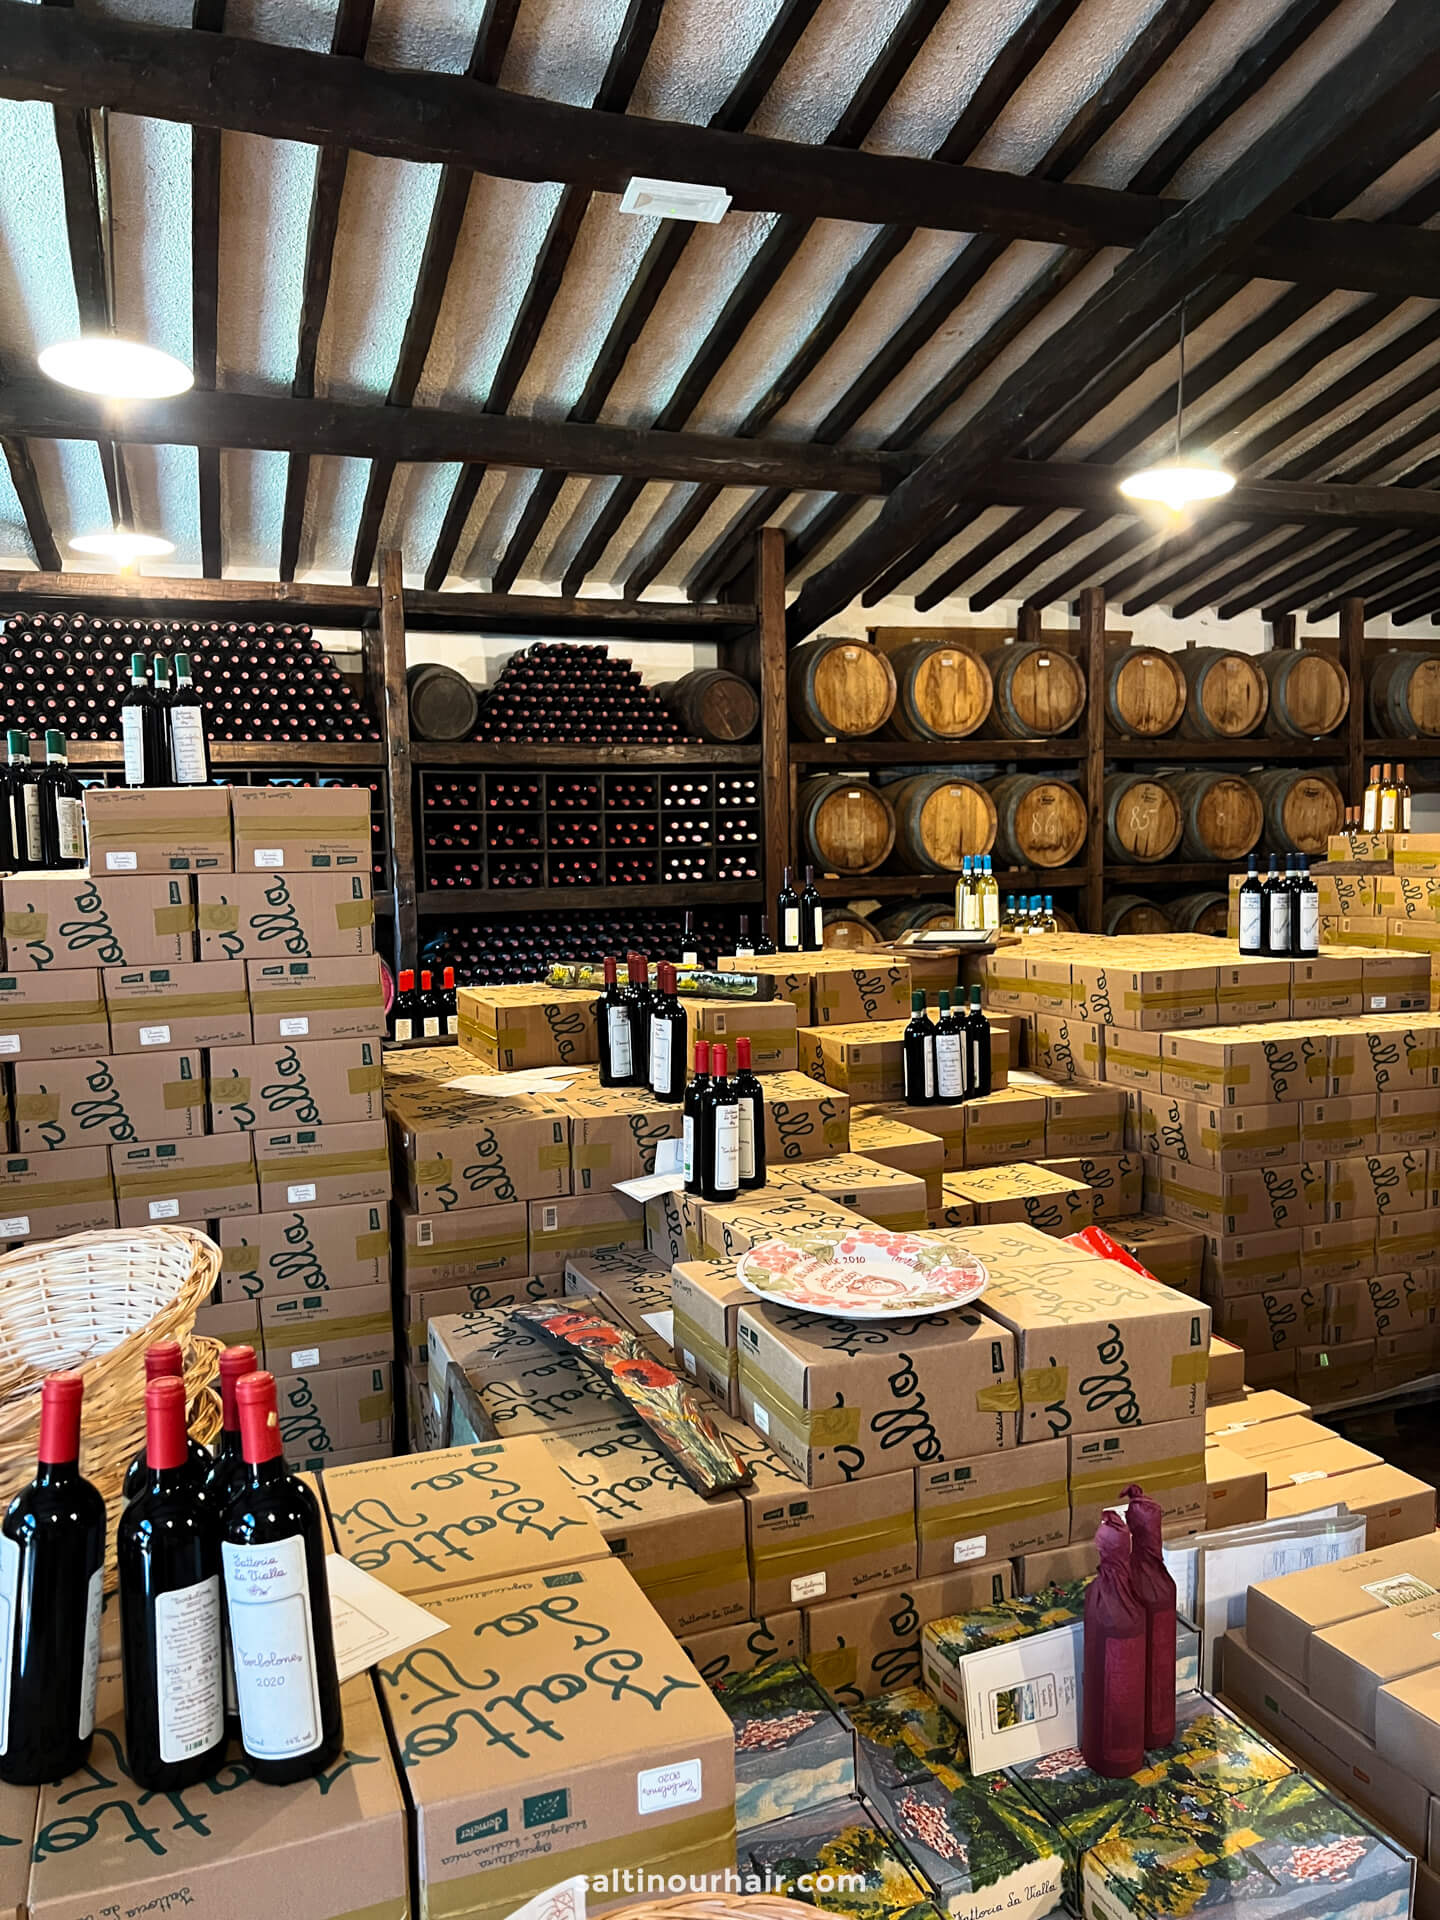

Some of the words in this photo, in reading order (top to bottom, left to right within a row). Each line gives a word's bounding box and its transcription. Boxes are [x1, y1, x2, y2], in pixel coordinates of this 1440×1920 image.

[1031, 810, 1057, 836] 86
[1129, 805, 1158, 831] 85
[1023, 1196, 1063, 1229] all
[255, 1675, 285, 1688] 2020
[459, 1814, 503, 1840] demeter
[1006, 1891, 1022, 1909] La
[1023, 1880, 1058, 1901] Vialla
